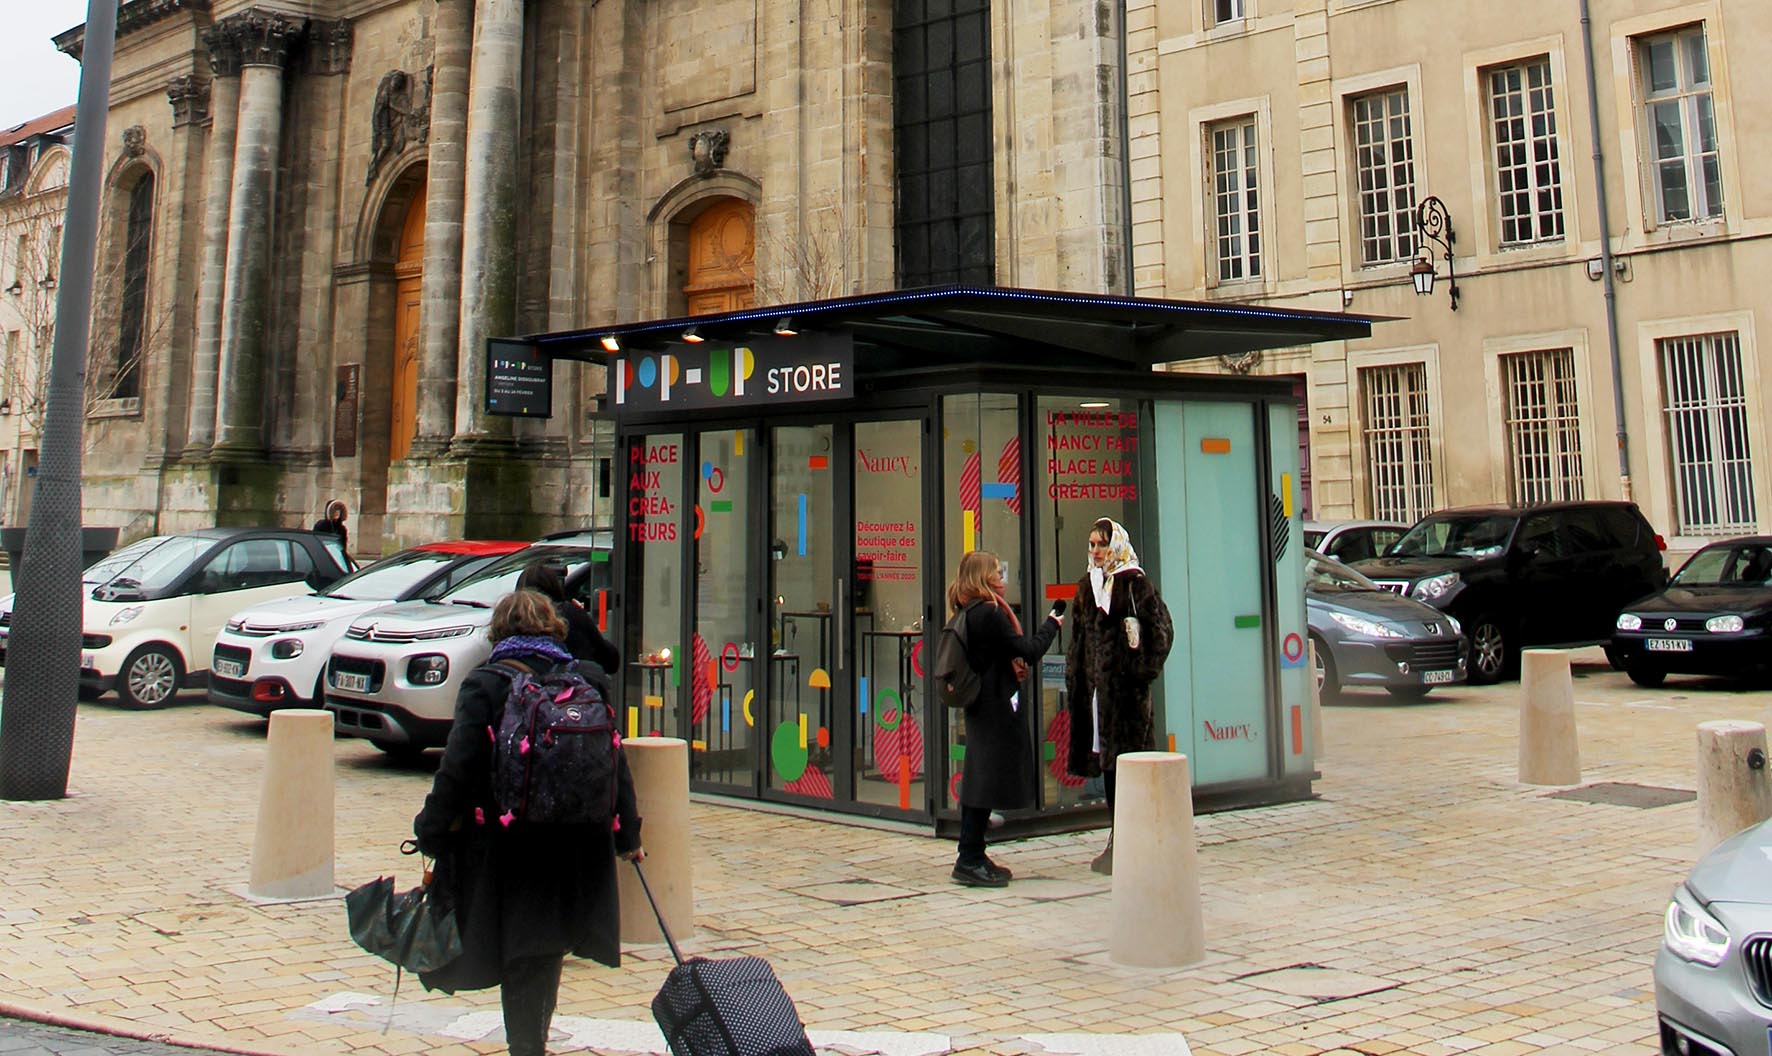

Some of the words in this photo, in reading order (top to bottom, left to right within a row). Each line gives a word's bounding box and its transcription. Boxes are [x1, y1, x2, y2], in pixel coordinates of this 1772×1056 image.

[616, 347, 755, 404] POP-UP
[767, 363, 841, 394] STORE
[1047, 410, 1067, 426] LA
[1071, 411, 1113, 428] VILLE
[1118, 412, 1137, 430] DE
[1047, 434, 1101, 451] NANCY
[1106, 436, 1137, 452] FAIT
[631, 445, 677, 464] PLACE
[1048, 459, 1096, 475] PLACE
[1102, 459, 1133, 476] AUX
[630, 471, 660, 490] AUX
[1048, 480, 1137, 500] CRÉATEURS
[629, 492, 675, 517] CRÉA-
[629, 523, 676, 542] TEURS
[857, 521, 903, 532] Découvrez
[906, 521, 914, 532] la
[857, 536, 897, 549] boutique
[899, 535, 916, 547] des
[857, 551, 907, 562] savoir-faire
